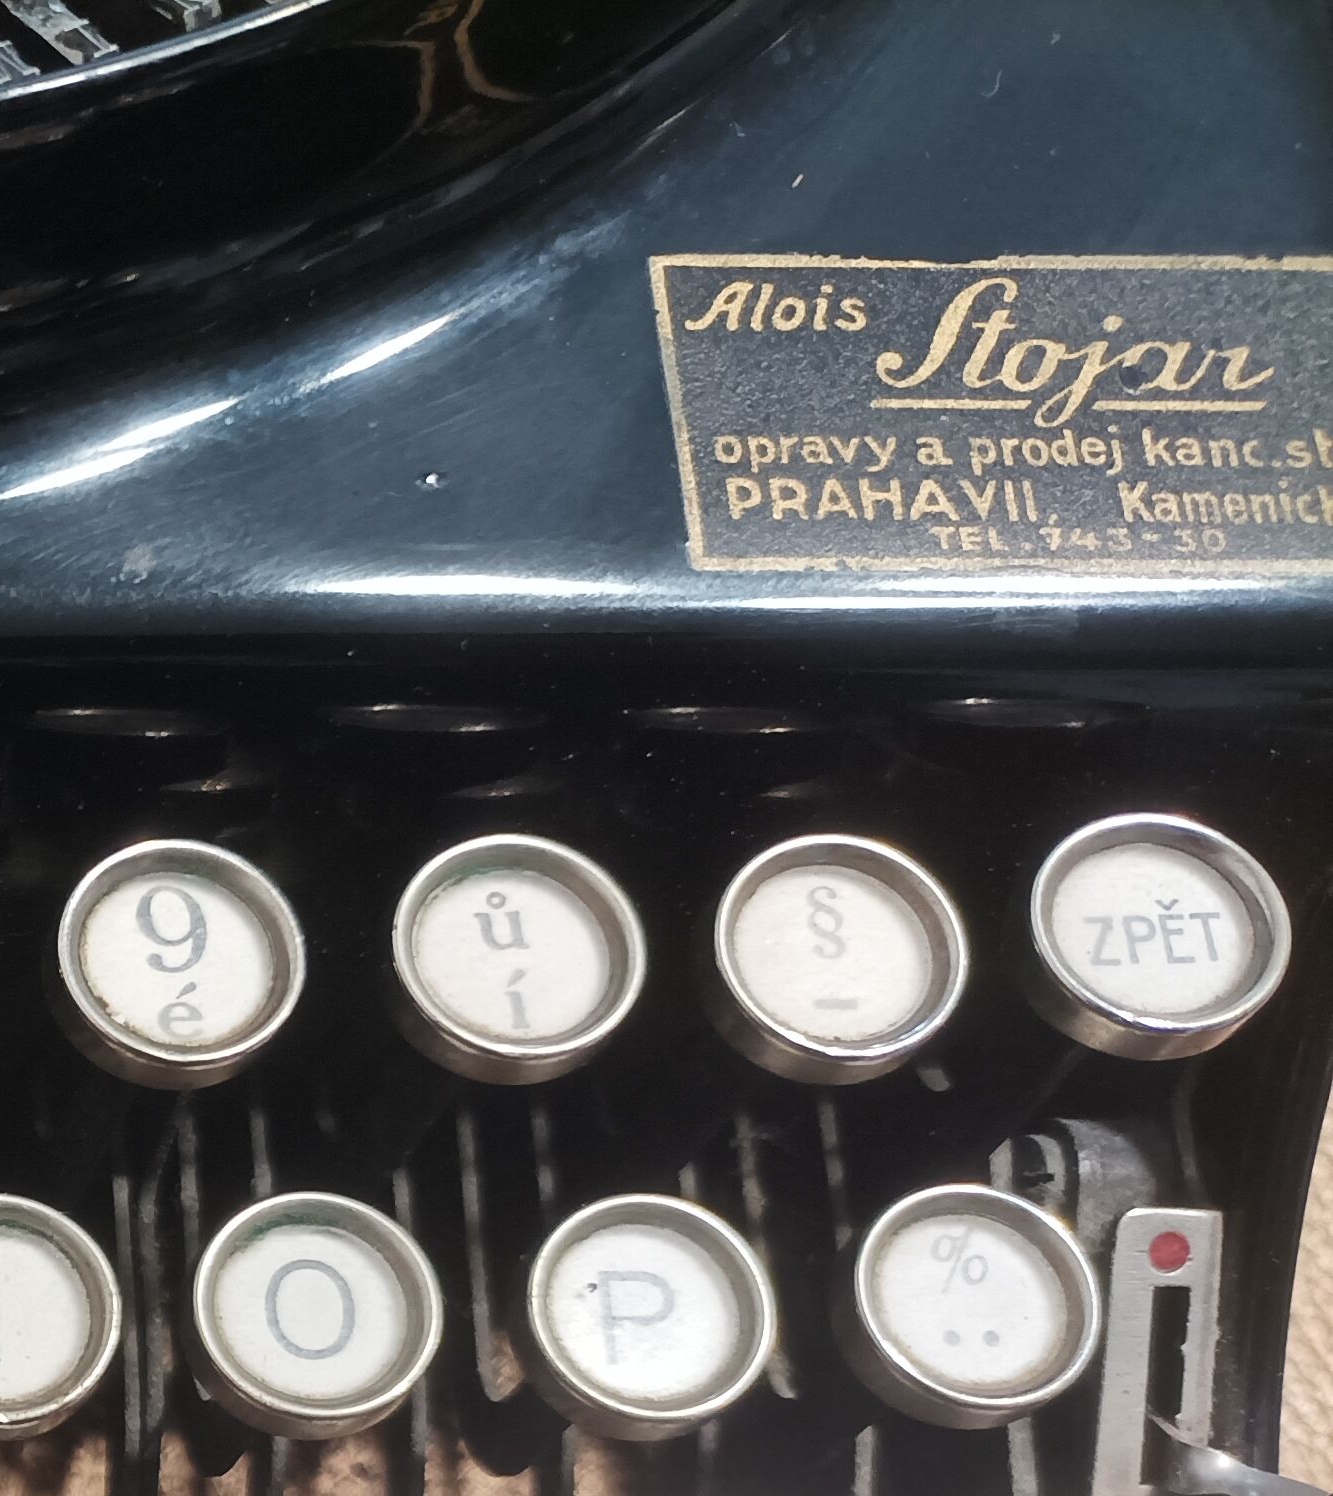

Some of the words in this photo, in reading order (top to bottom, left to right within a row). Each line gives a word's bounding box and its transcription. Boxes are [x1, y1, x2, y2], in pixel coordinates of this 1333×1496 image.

[684, 281, 868, 332] Alois
[875, 276, 1274, 427] Stojar
[713, 434, 898, 474] opravy
[916, 435, 953, 466] a
[969, 424, 1123, 476] prodej
[136, 886, 208, 972] 9
[474, 891, 530, 951] ů
[1084, 899, 1221, 966] ZPĚT
[158, 982, 203, 1038] é
[504, 969, 531, 1029] í
[264, 1259, 355, 1361] O
[598, 1269, 676, 1365] P
